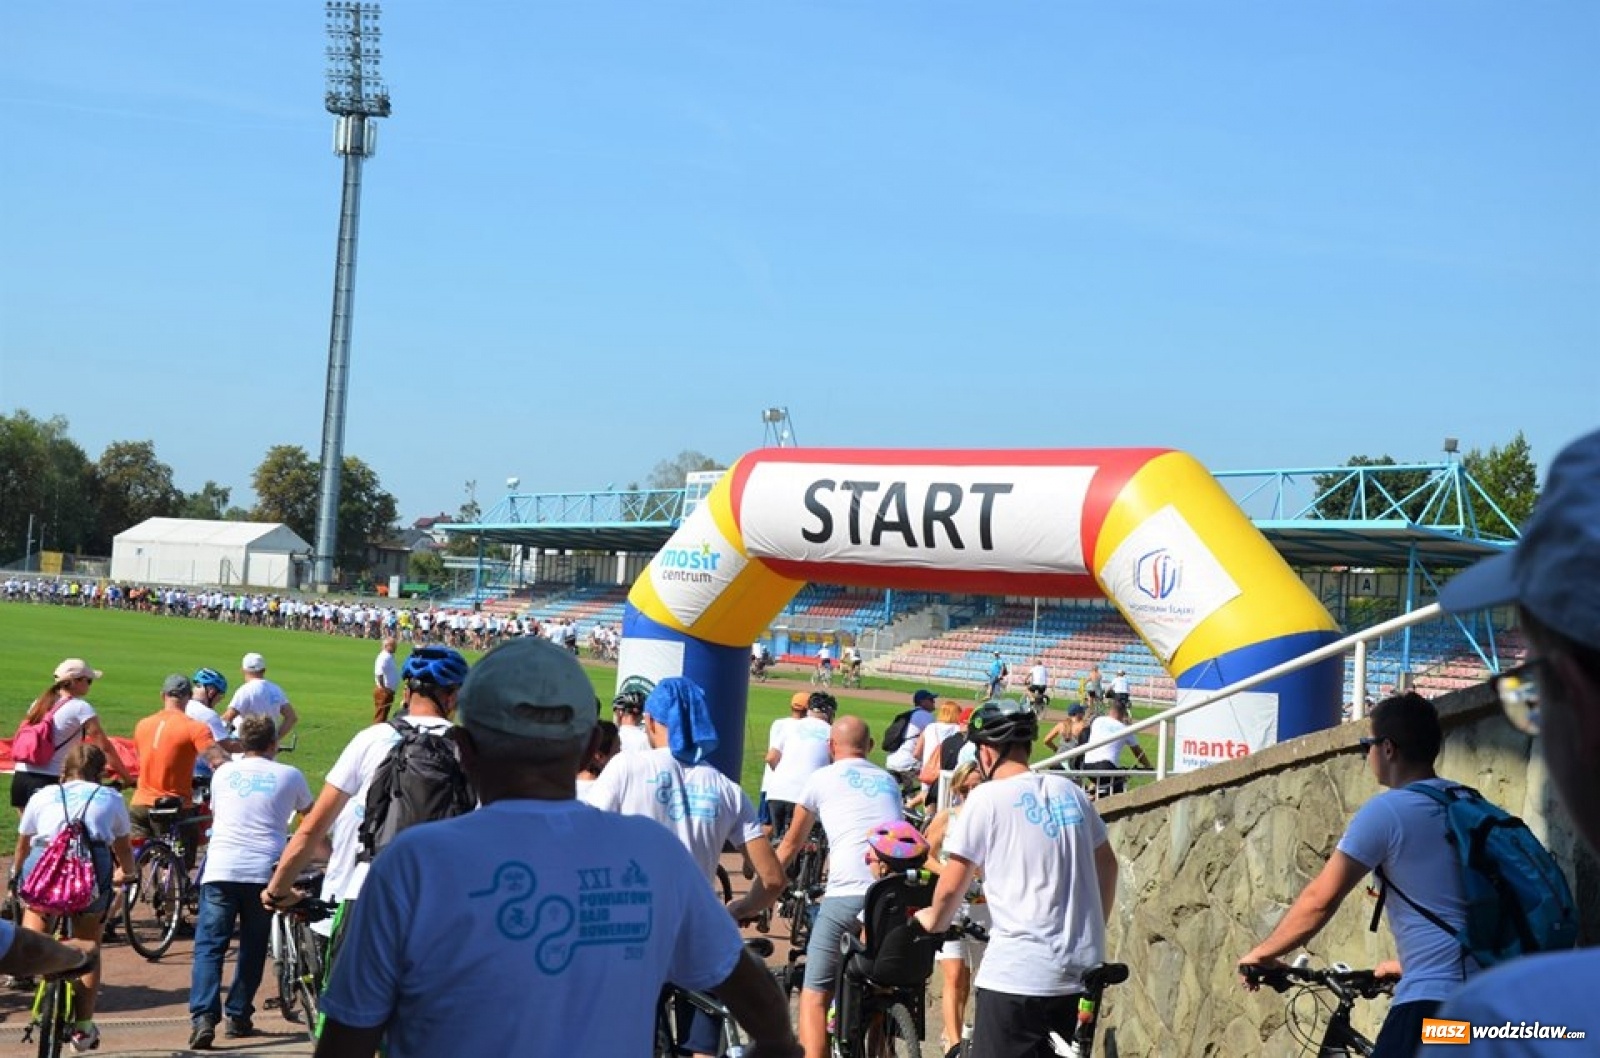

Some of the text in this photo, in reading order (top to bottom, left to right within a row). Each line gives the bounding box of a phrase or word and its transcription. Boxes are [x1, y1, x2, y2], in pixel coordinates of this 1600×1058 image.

[803, 478, 1013, 550] START
[662, 569, 713, 583] centrum
[1362, 578, 1371, 591] A
[1183, 739, 1250, 758] manta
[577, 867, 612, 890] XXI
